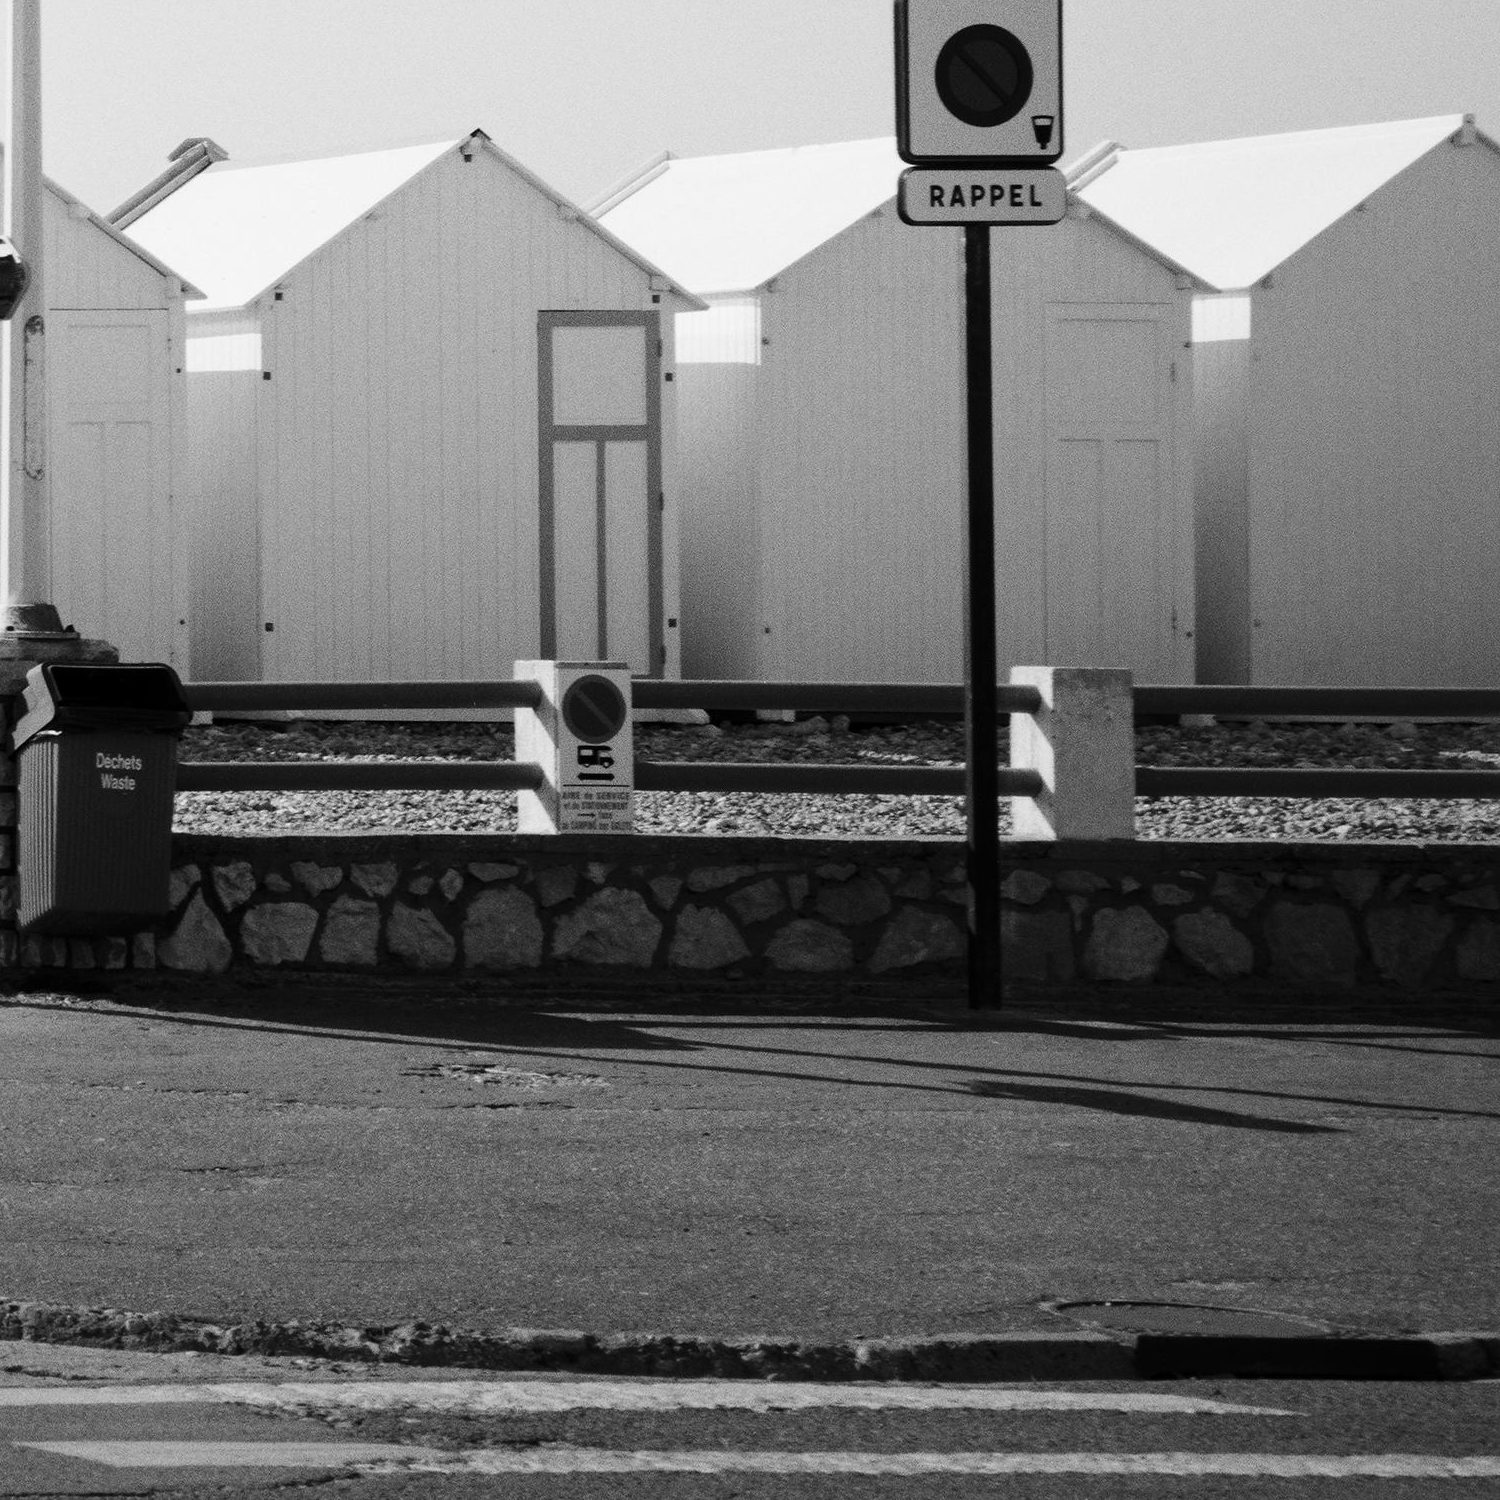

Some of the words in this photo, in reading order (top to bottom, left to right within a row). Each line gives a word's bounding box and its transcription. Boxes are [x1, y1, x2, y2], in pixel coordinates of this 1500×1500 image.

[929, 184, 1043, 207] RAPPEL
[95, 752, 143, 771] Déchets
[100, 773, 136, 791] Waste
